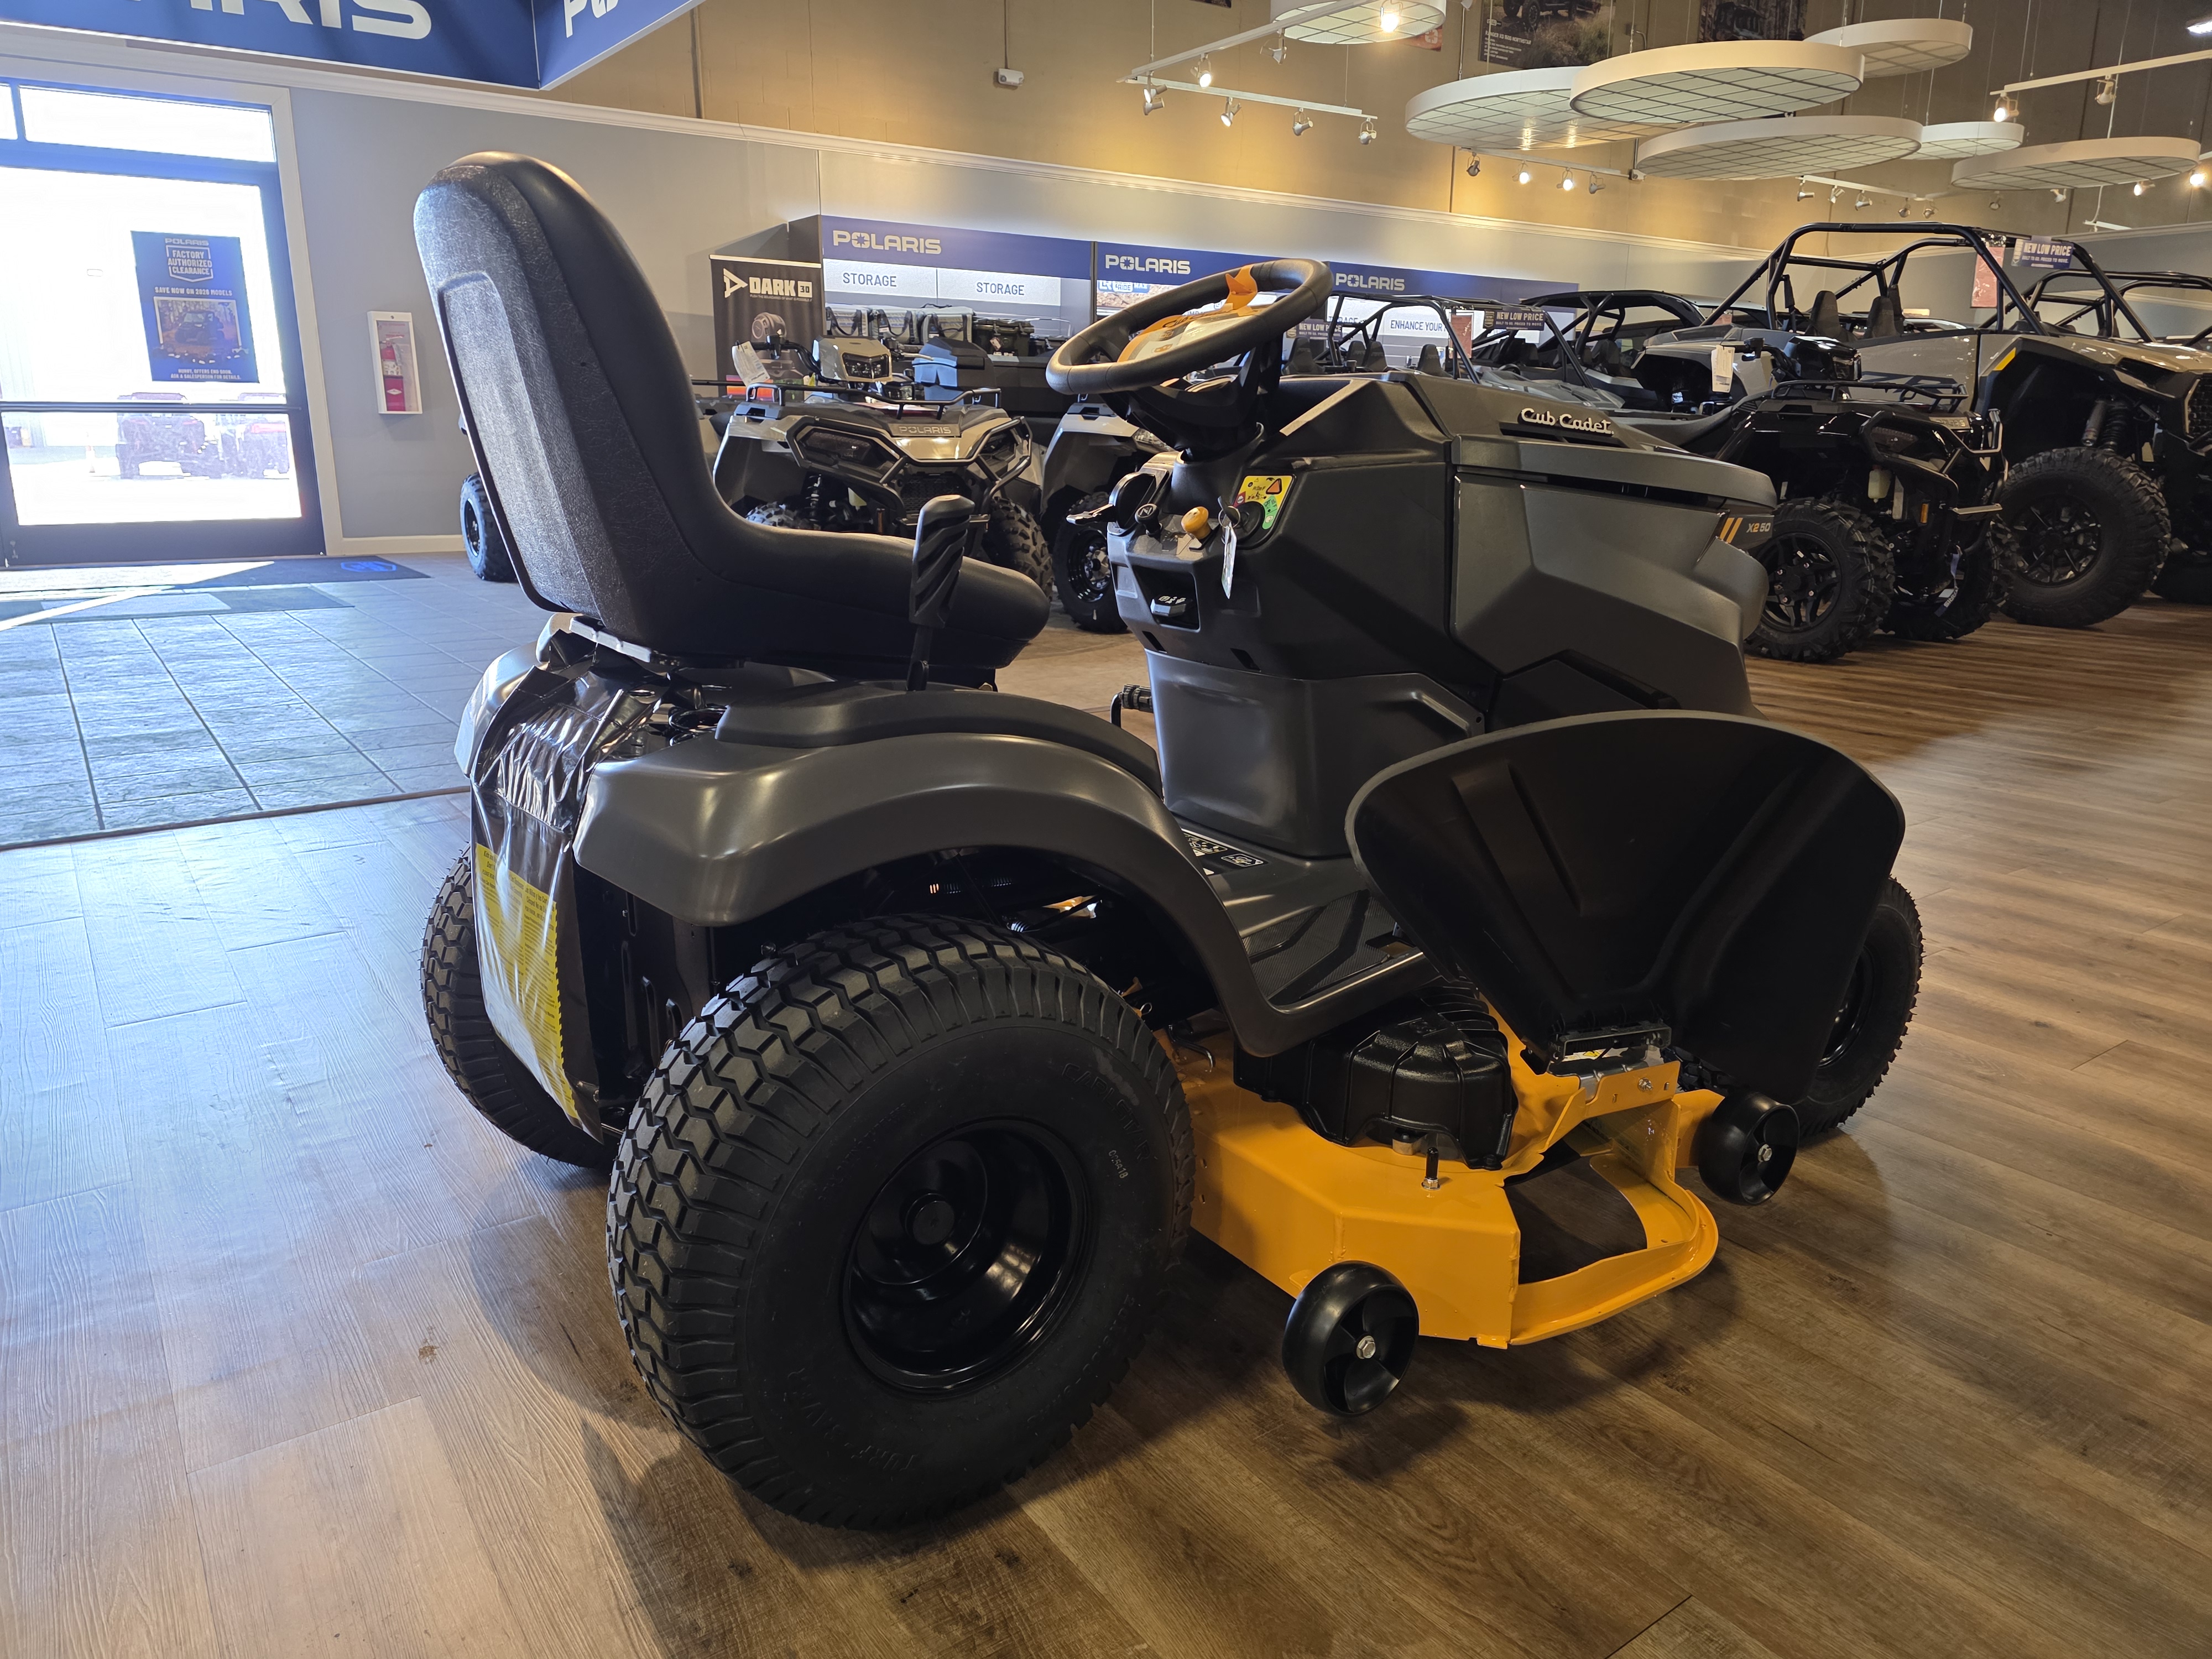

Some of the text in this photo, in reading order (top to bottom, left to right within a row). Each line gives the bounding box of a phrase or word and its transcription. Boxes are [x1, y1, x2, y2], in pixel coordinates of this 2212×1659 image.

[833, 230, 942, 254] POLARIS
[2023, 242, 2072, 256] NEW LOW PRICE
[172, 250, 204, 259] FACTORY
[168, 258, 212, 268] AUTHORIZED
[1105, 254, 1191, 275] POLARIS
[172, 266, 210, 275] CLEARANCE
[749, 277, 796, 296] DARK
[843, 273, 897, 287] STORAGE
[1335, 273, 1405, 291] POLARIS
[976, 282, 1025, 296] STORAGE
[1496, 311, 1509, 320] NEW
[1510, 312, 1522, 321] LOW
[1523, 313, 1543, 321] PRICE
[1390, 320, 1443, 332] ENHANCE YOUR
[1521, 408, 1612, 435] Cub Cadet
[1062, 1063, 1151, 1161] CARLSTAR
